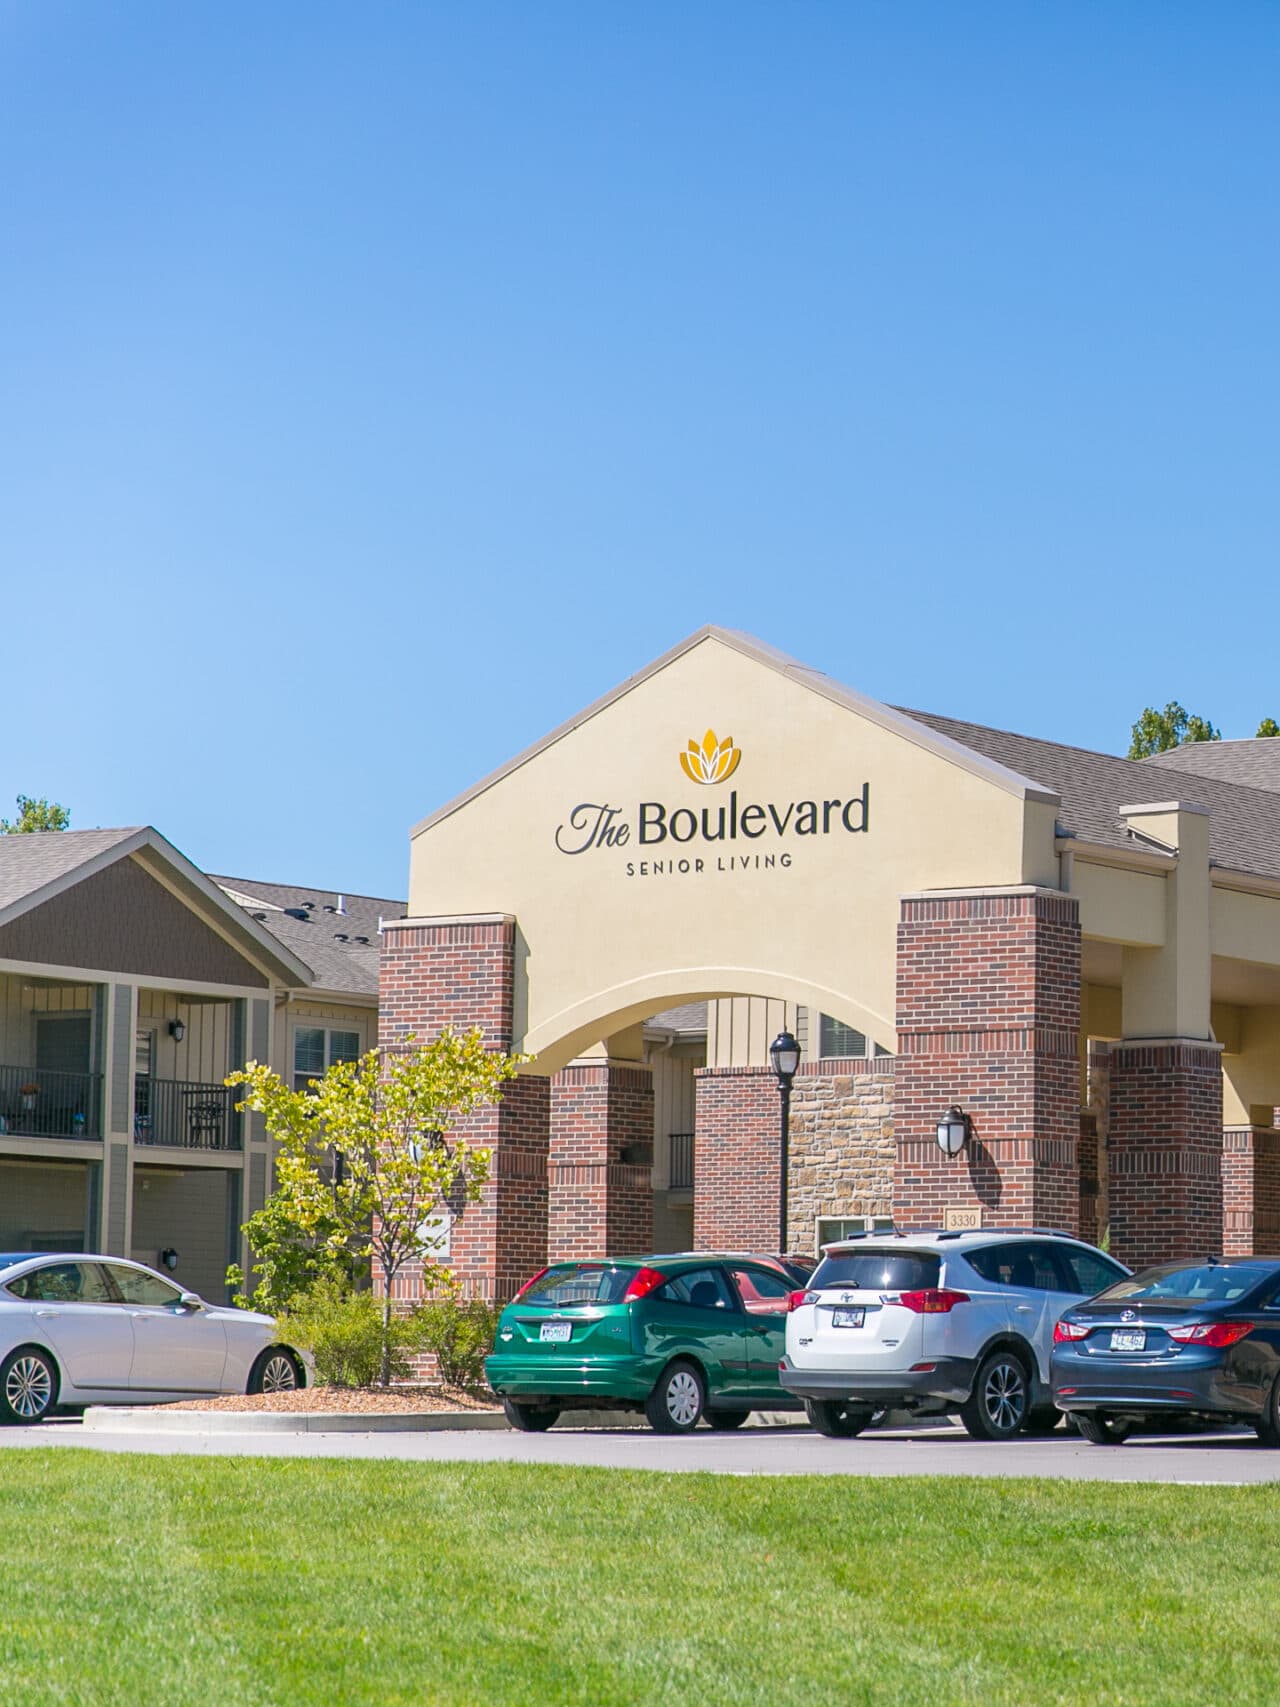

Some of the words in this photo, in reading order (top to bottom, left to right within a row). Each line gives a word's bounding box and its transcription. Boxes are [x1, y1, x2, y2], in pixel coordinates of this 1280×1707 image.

[555, 803, 630, 855] The
[638, 782, 870, 845] Boulevard
[626, 859, 705, 876] SENIOR
[717, 853, 793, 871] LIVING
[950, 1214, 976, 1227] 3330
